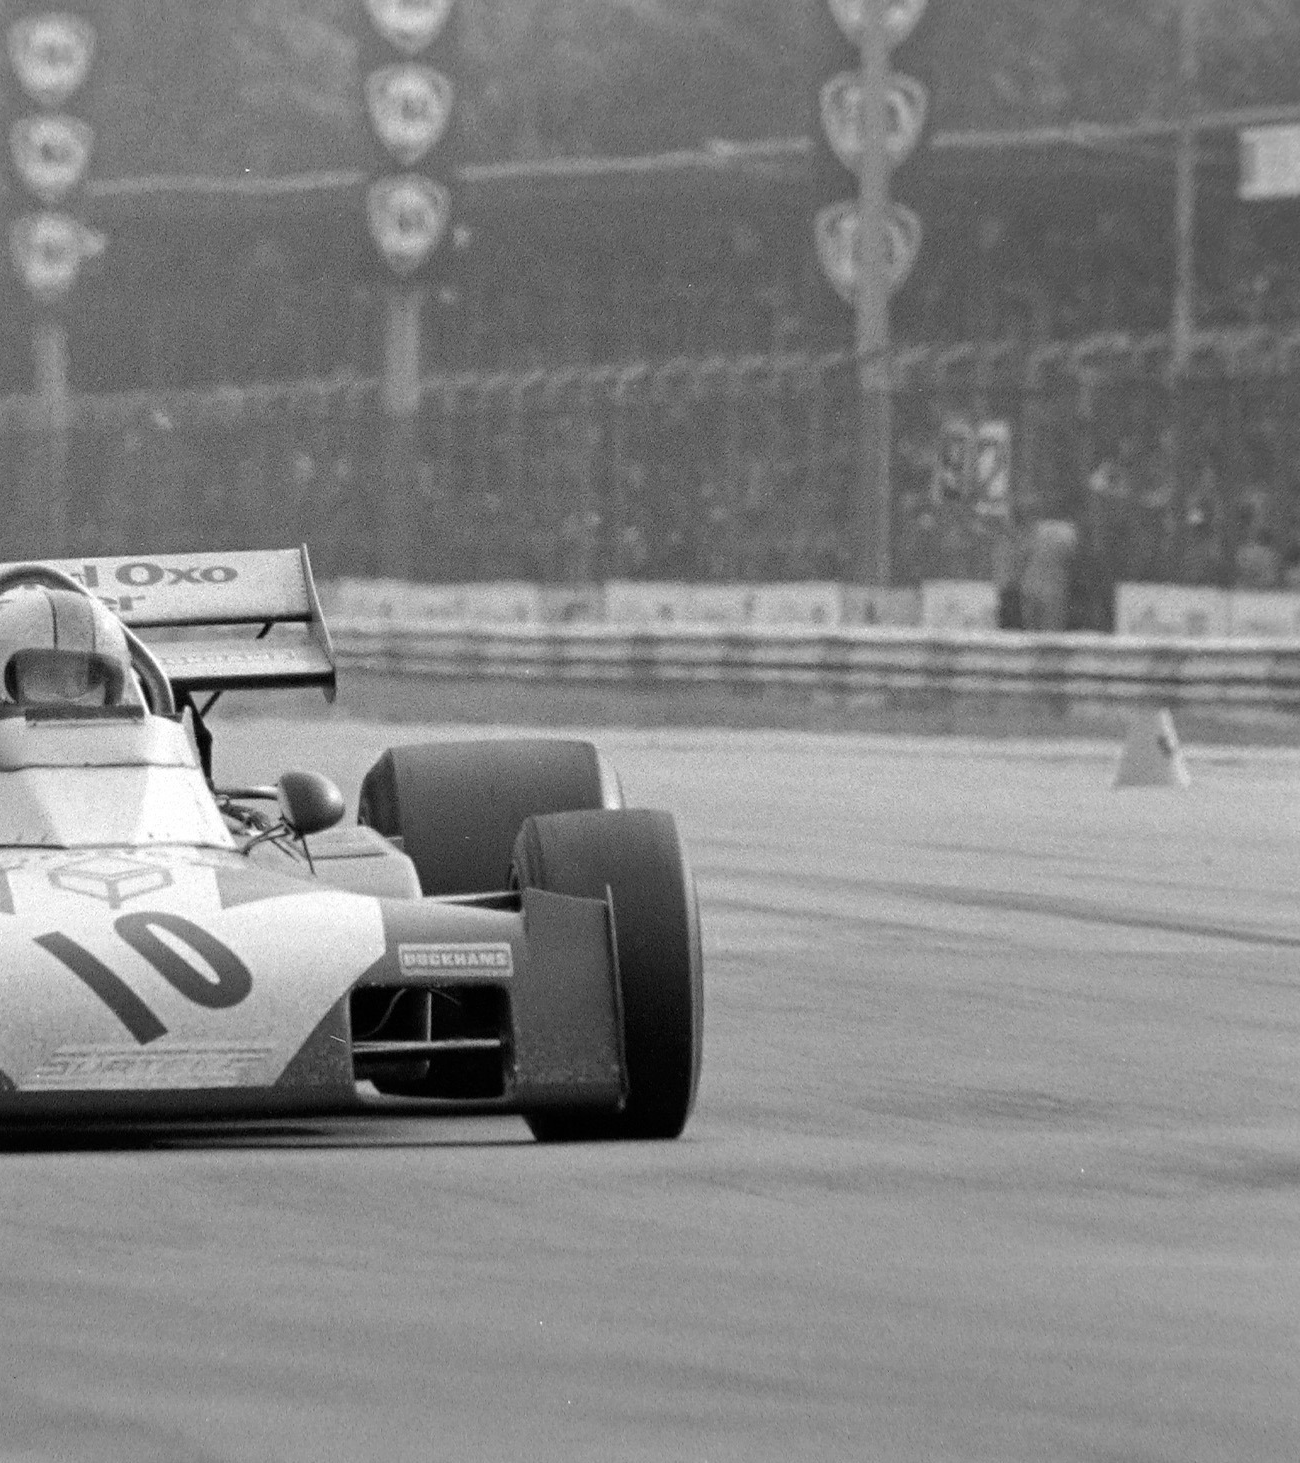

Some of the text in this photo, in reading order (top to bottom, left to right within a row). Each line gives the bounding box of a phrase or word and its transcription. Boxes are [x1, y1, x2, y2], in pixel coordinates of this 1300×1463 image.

[114, 562, 239, 587] Oxo
[402, 951, 508, 967] DUCKHAMS
[33, 911, 253, 1045] 10
